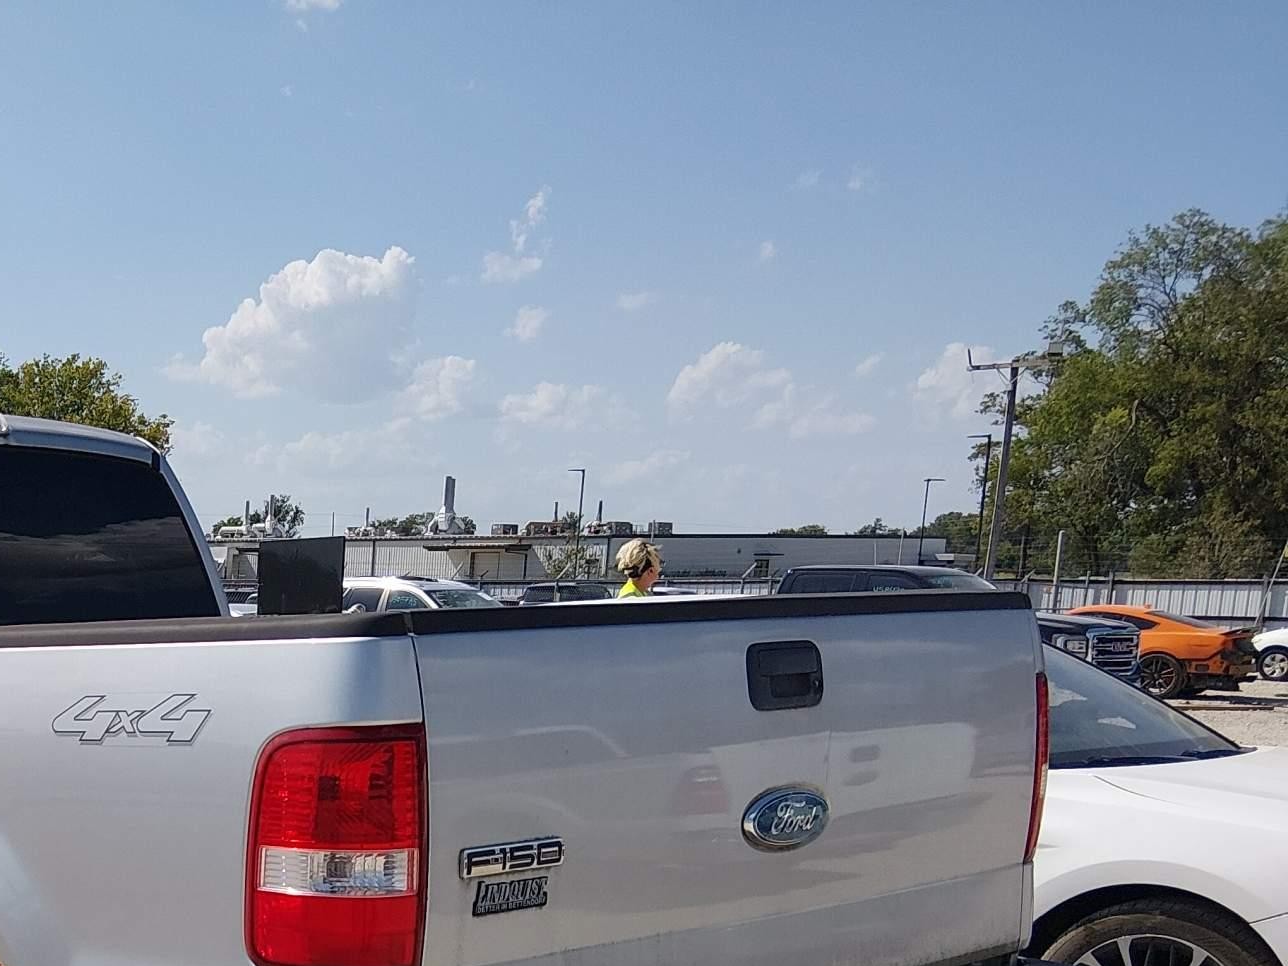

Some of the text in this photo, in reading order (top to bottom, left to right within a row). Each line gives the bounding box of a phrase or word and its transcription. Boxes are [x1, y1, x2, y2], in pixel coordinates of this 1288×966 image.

[51, 693, 212, 745] 4x4
[771, 800, 817, 835] Ford
[477, 878, 548, 906] LINDQUIST
